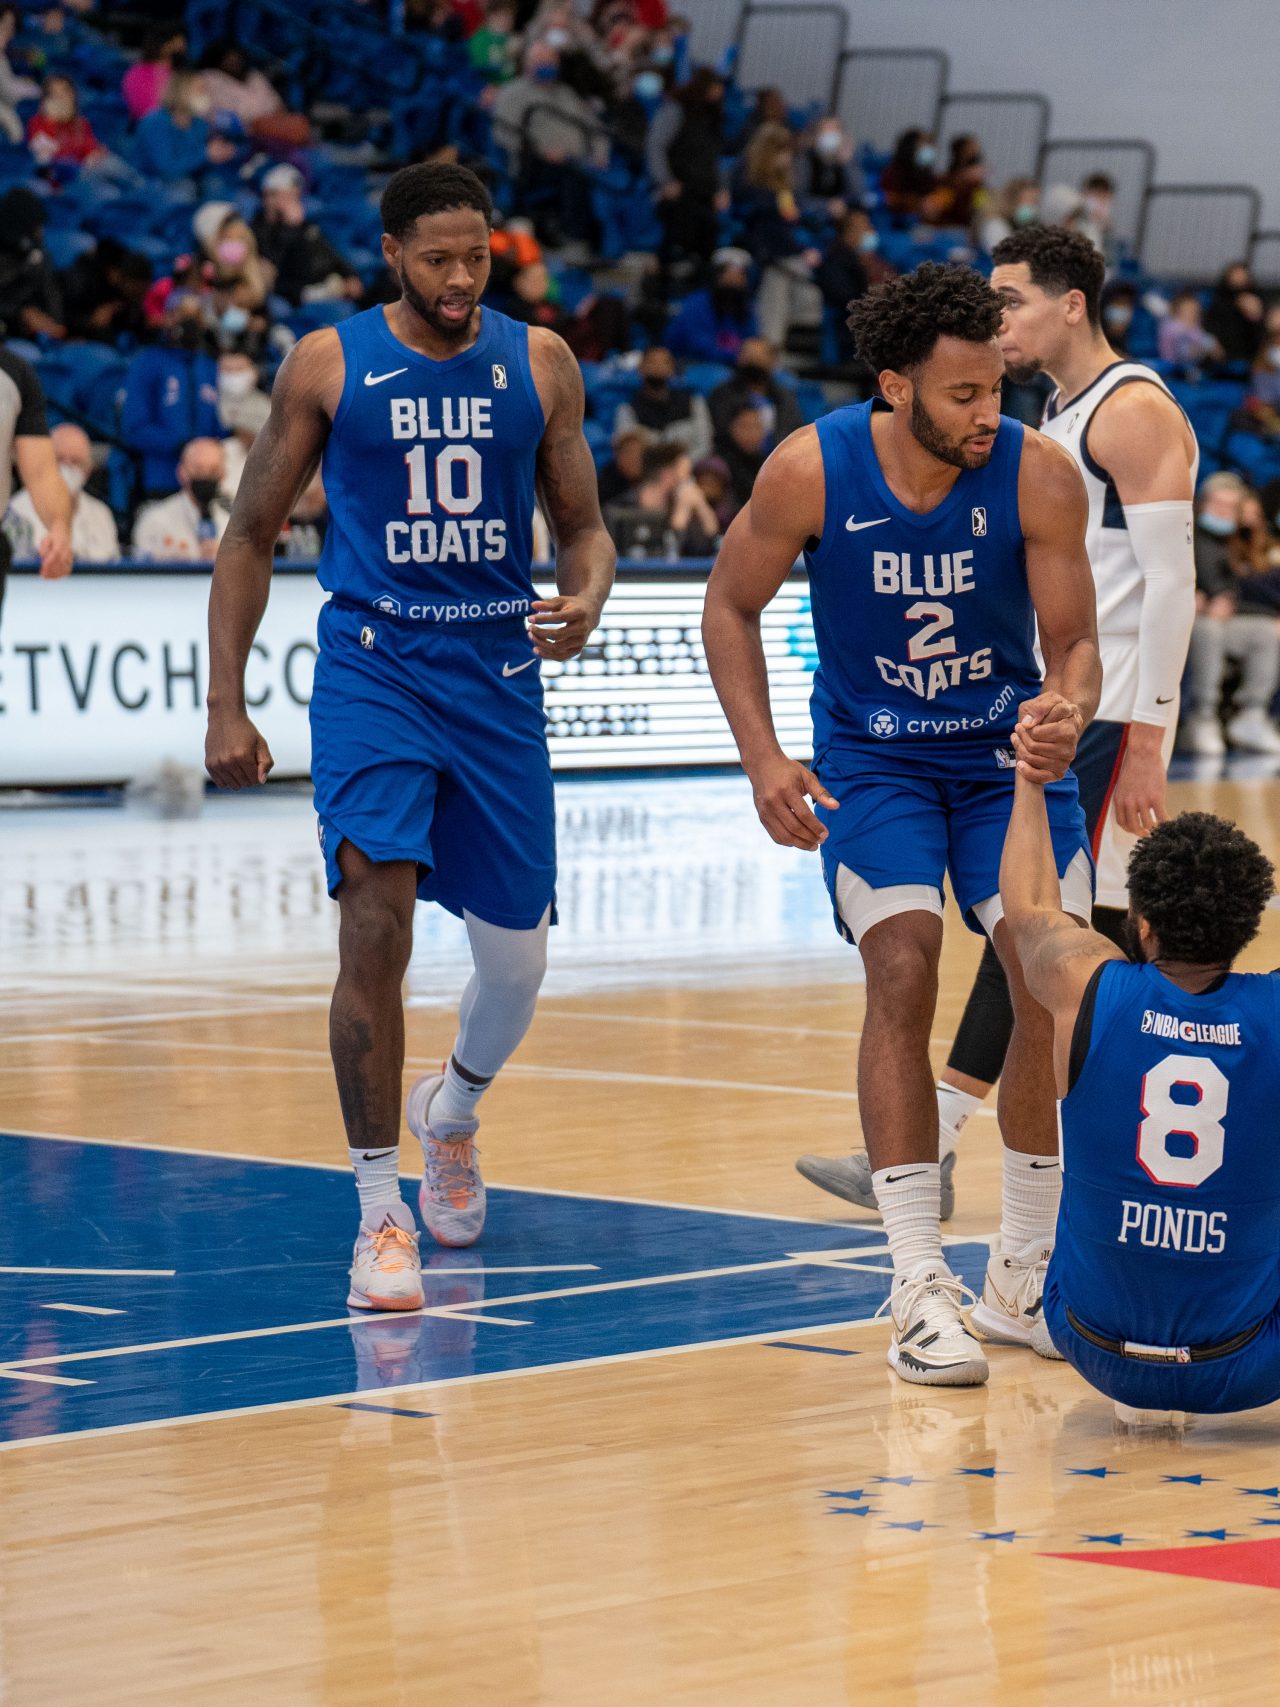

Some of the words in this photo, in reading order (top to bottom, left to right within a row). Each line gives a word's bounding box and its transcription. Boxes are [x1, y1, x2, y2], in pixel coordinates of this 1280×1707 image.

[390, 397, 493, 439] BLUE
[404, 445, 483, 515] 10
[385, 519, 507, 564] COATS
[873, 549, 976, 596] BLUE
[408, 598, 529, 622] crypto.com
[904, 601, 960, 661] 2
[874, 647, 992, 701] COATS
[906, 683, 1016, 734] crypto.com
[1136, 1054, 1230, 1188] 8
[1117, 1200, 1228, 1254] PONDS
